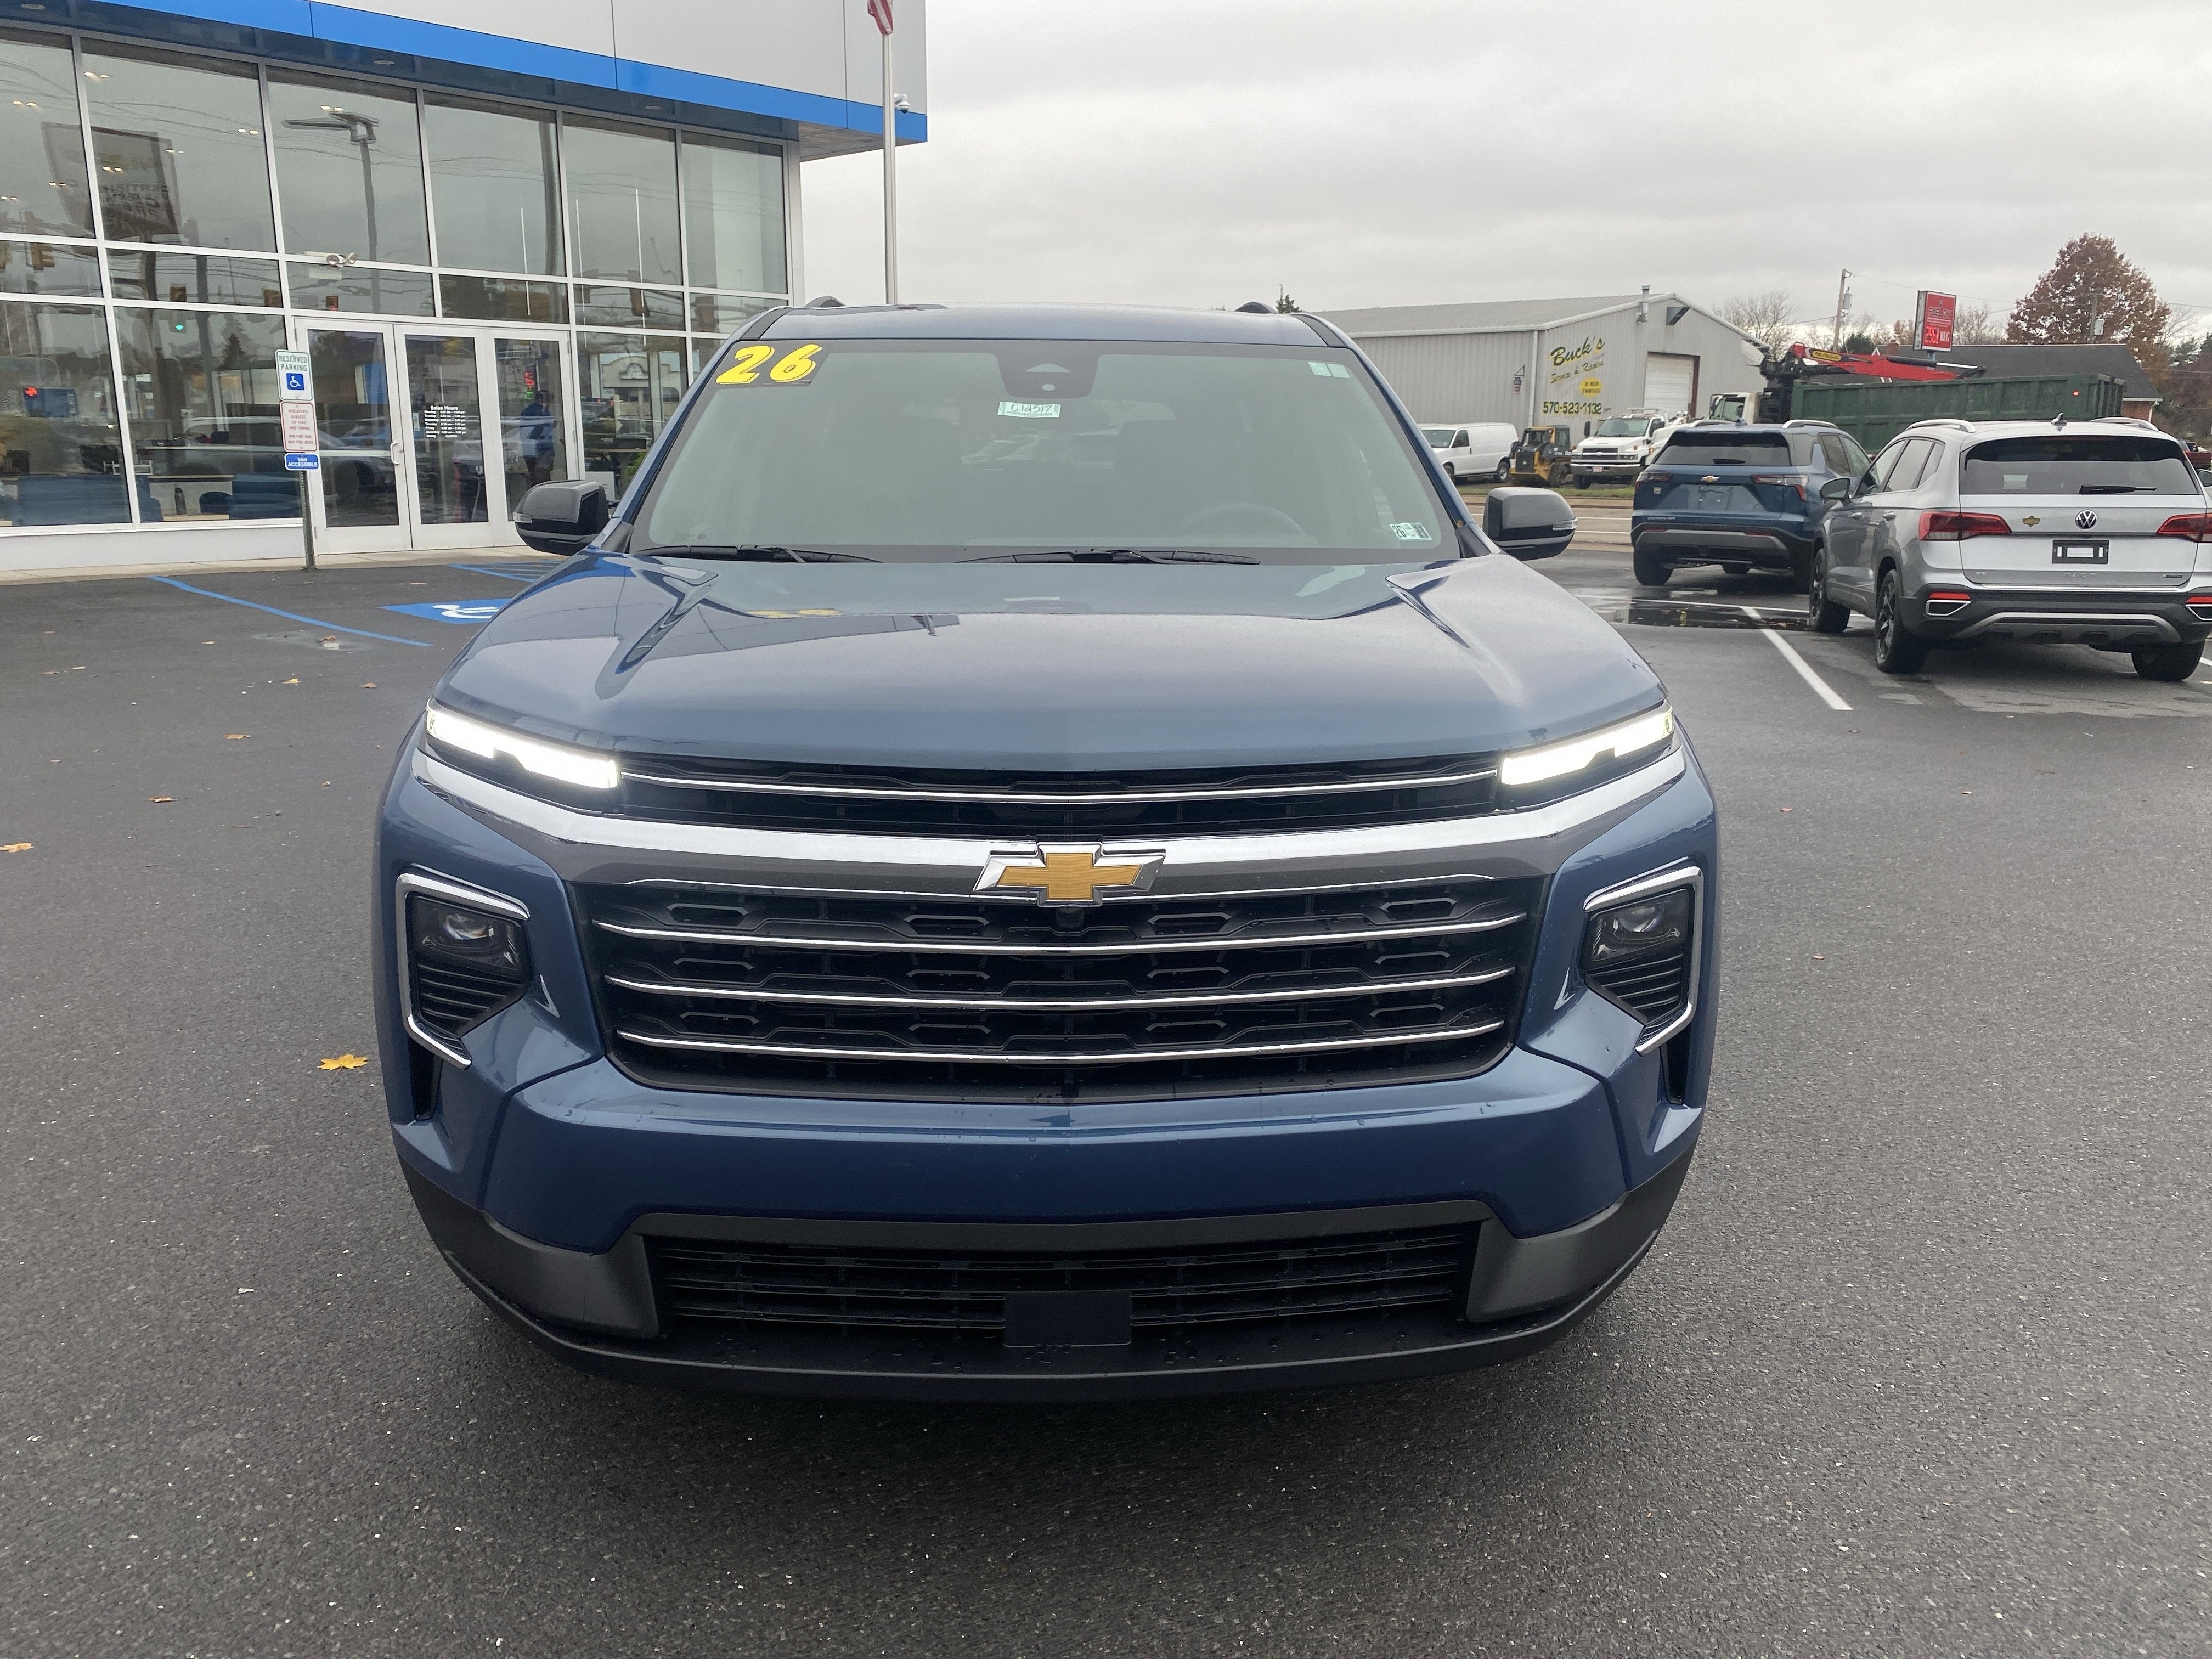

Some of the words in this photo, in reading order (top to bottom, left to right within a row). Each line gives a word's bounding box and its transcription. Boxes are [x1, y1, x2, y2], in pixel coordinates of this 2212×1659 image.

[279, 355, 307, 363] RESERVED
[1550, 336, 1605, 366] Buck's
[715, 342, 822, 385] 26
[1391, 525, 1407, 538] 26
